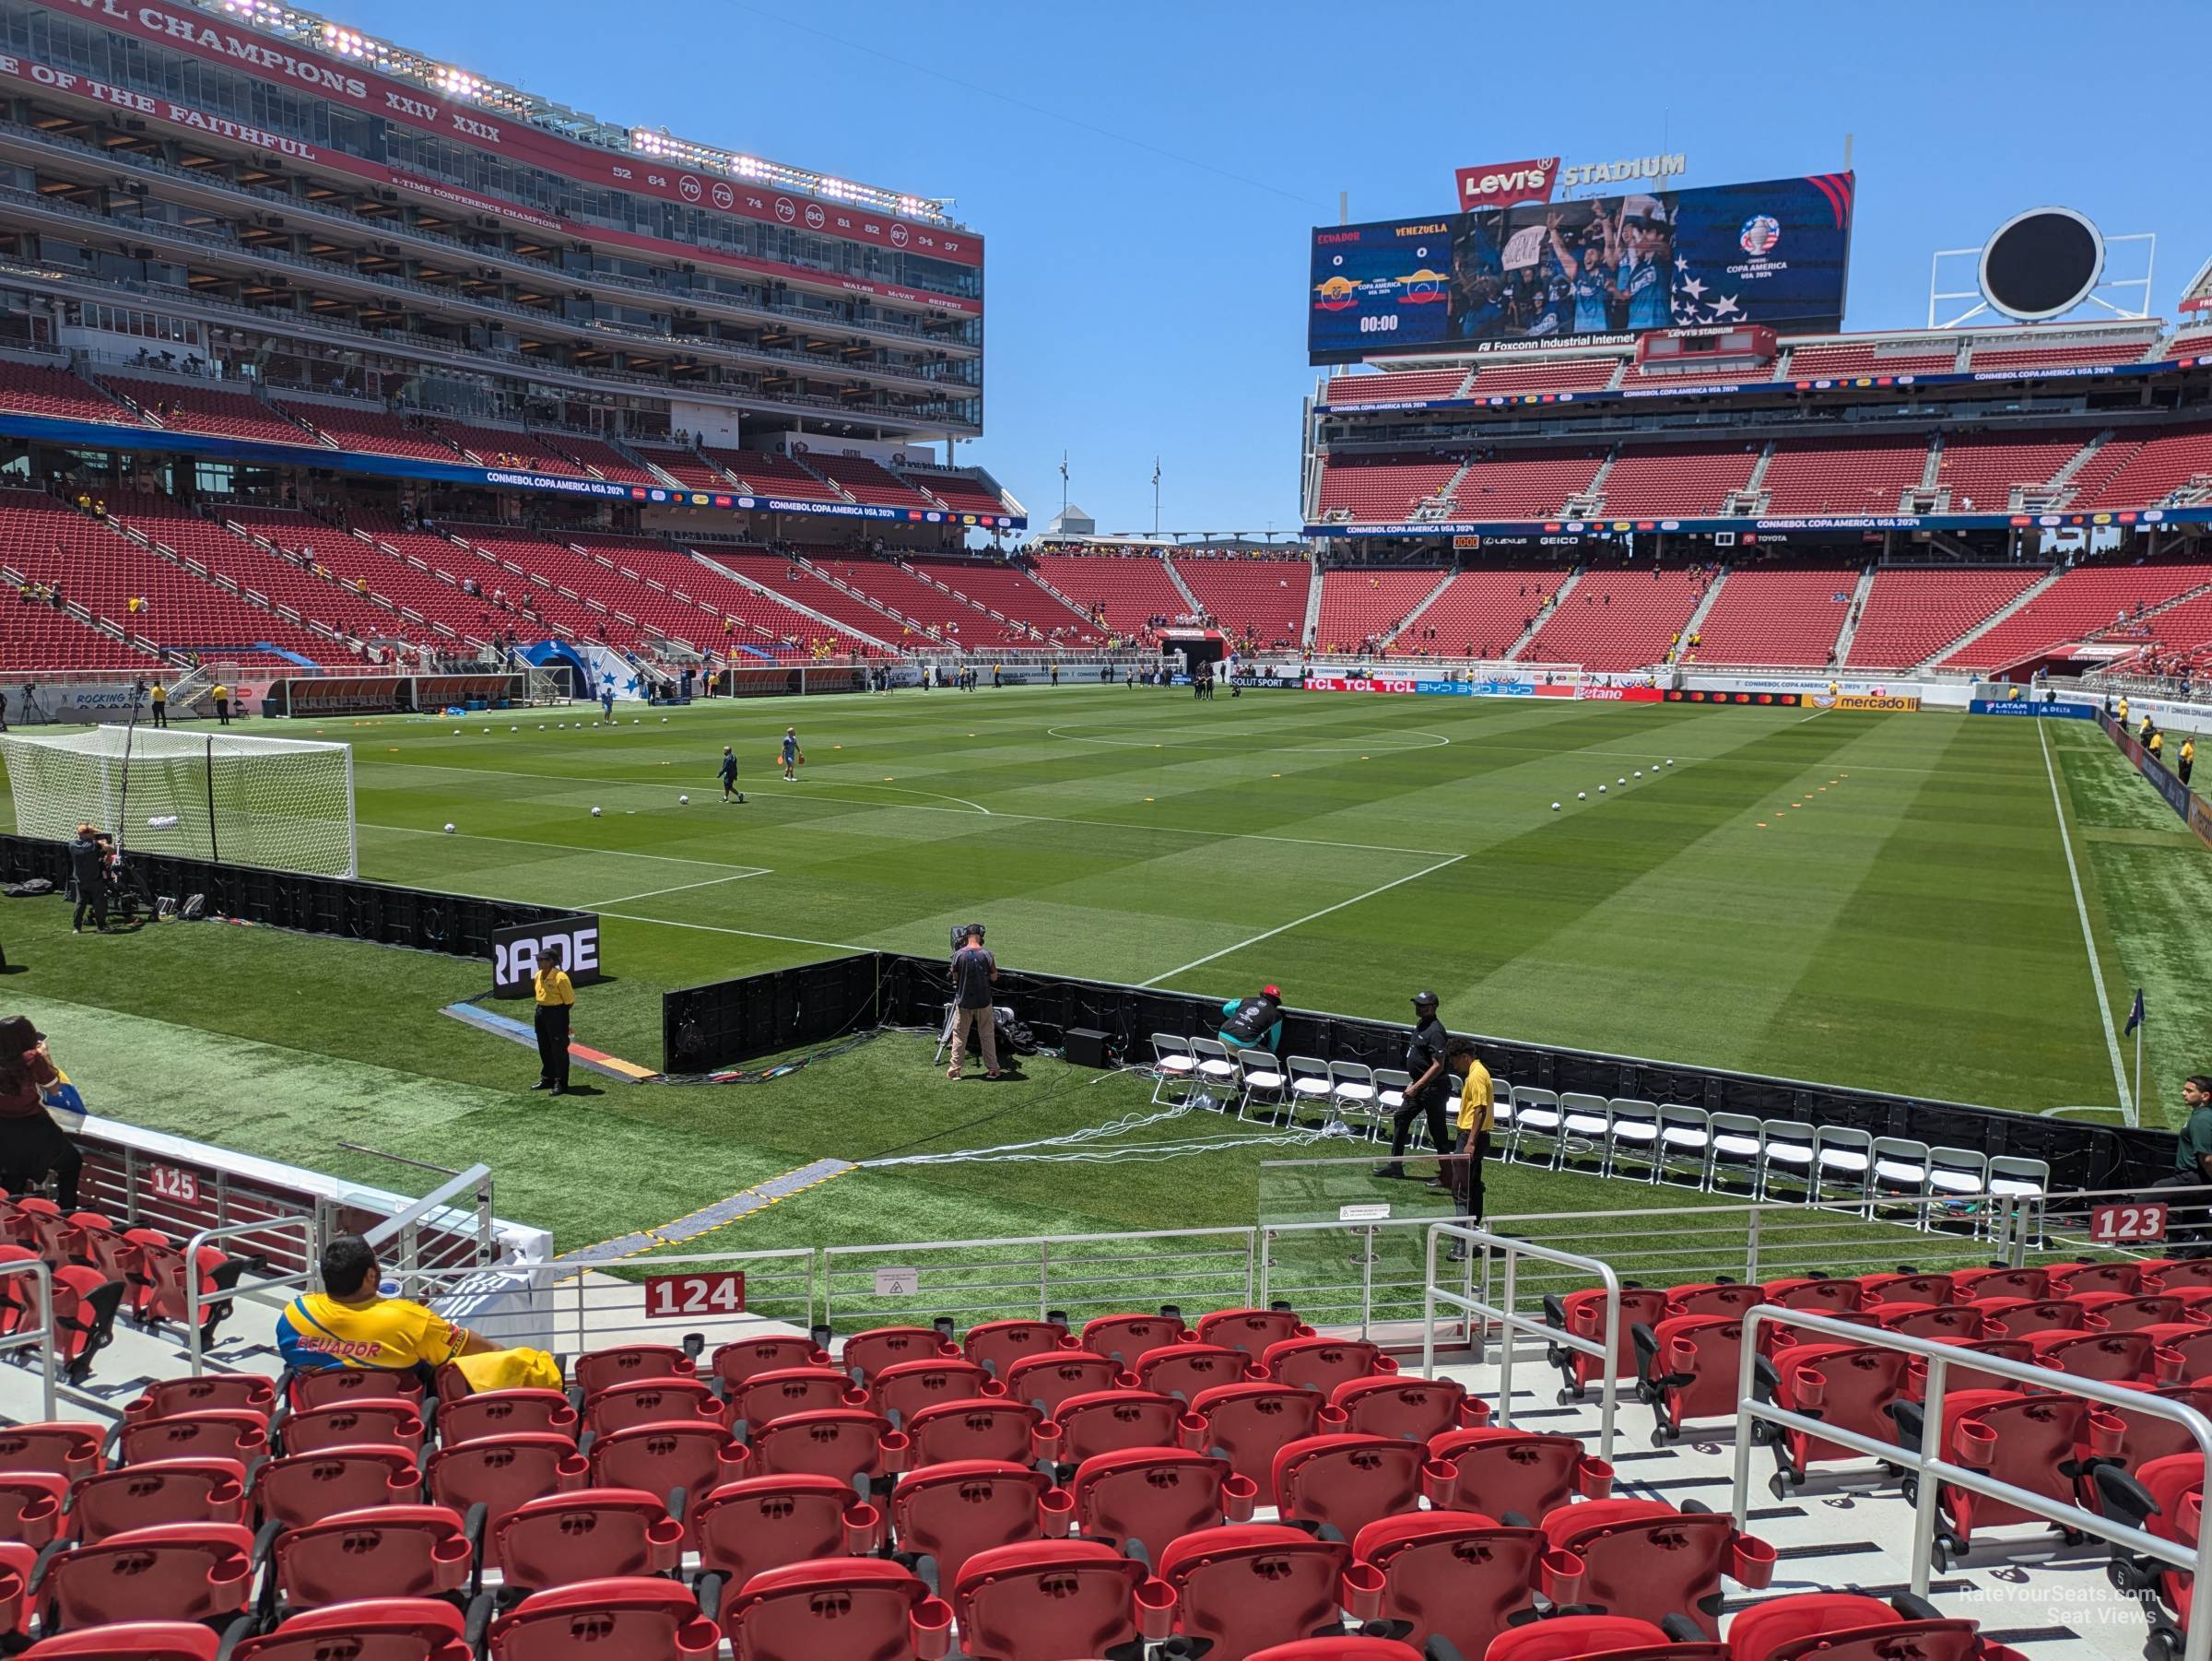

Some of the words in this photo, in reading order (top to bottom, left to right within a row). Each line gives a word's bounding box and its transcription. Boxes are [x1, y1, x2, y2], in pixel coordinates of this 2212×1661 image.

[139, 8, 368, 99] CHAMPIONS
[385, 91, 439, 122] XXIV
[452, 113, 500, 143] XXIX
[30, 65, 77, 89] OF
[87, 80, 156, 114] THE
[169, 104, 315, 160] FAITHFUL
[613, 167, 632, 180] 52
[1563, 154, 1687, 186] STADIUM
[648, 175, 667, 187] 64
[682, 183, 699, 194] 70
[714, 190, 732, 202] 73
[433, 189, 502, 214] CONFERENCE
[502, 209, 561, 230] CHAMPIONS
[777, 204, 794, 215] 79
[807, 211, 823, 222] 80
[837, 218, 851, 229] 81
[865, 224, 880, 235] 82
[892, 230, 908, 241] 87
[1395, 223, 1448, 237] VENEZUELA
[1317, 232, 1360, 244] ECUADOR
[1726, 265, 1749, 274] COPA
[1750, 262, 1788, 271] AMERICA
[842, 281, 875, 293] WALSH
[888, 290, 915, 301] McVAY
[929, 298, 962, 310] SEIFERT
[1360, 314, 1398, 332] 00:00
[1699, 326, 1734, 336] STADIUM
[1494, 339, 1538, 351] Foxconn
[1540, 335, 1591, 348] Industrial
[1593, 333, 1635, 345] Internet
[1975, 371, 2018, 380] CONMEBOL
[2018, 370, 2040, 378] COPA
[2040, 369, 2075, 377] AMERICA
[487, 472, 534, 486] CONMEBOL
[535, 477, 556, 488] COPA
[556, 479, 590, 492] AMERICA
[592, 484, 606, 494] USA
[606, 486, 625, 495] 2024
[770, 501, 811, 512] CONMEBOL
[811, 505, 830, 513] COPA
[830, 506, 863, 515] AMERICA
[1347, 525, 1385, 534] CONMEBOL
[1406, 524, 1439, 533] AMERICA
[1441, 524, 1454, 533] USA
[1757, 520, 1806, 528] CONMEBOL
[1807, 519, 1833, 527] COPA
[1833, 519, 1875, 527] AMERICA
[1540, 536, 1579, 545] GEICO
[1257, 678, 1284, 687] SPORT
[1305, 678, 1336, 689] TCL
[1344, 680, 1375, 691] TCL
[1382, 681, 1416, 691] TCL
[76, 693, 124, 703] ROCKING
[1578, 687, 1623, 700] Betano
[1841, 697, 1905, 708] mercado
[155, 1168, 194, 1199] 125
[2098, 1207, 2160, 1238] 123
[654, 1278, 738, 1314] 124
[297, 1336, 383, 1358] ECUADOR
[2117, 1571, 2124, 1585] 5
